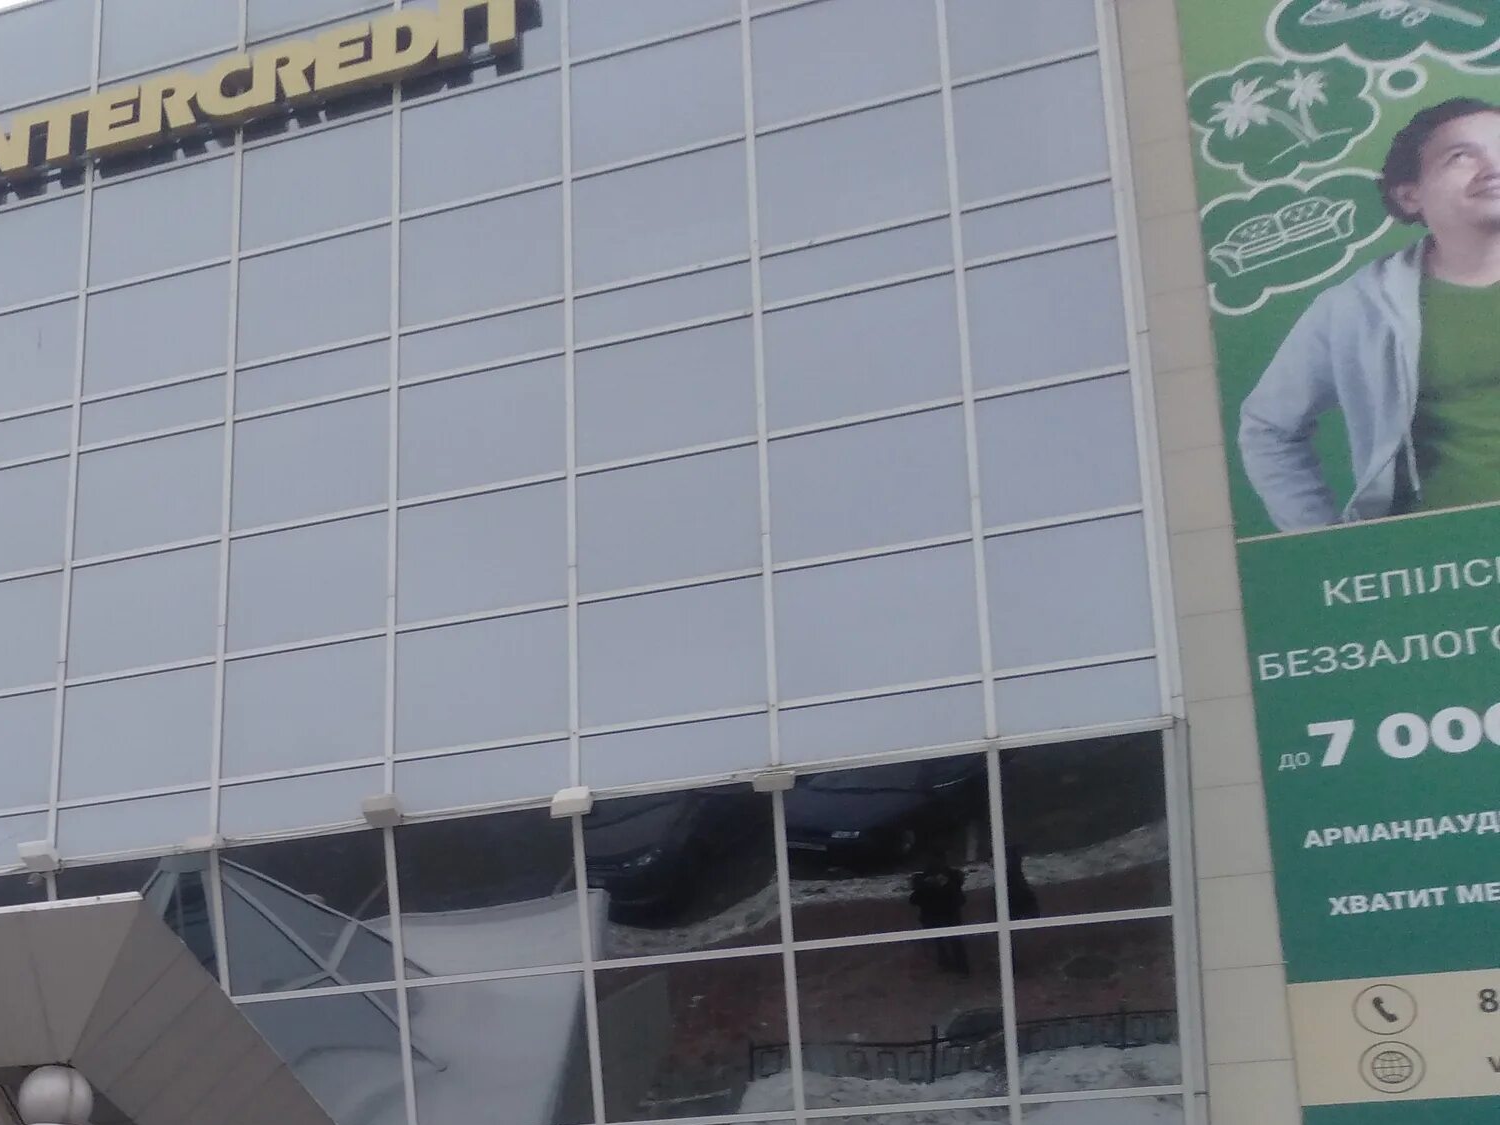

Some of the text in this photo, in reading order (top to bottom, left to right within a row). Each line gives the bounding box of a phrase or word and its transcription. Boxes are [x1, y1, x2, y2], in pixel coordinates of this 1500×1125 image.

[1323, 556, 1500, 606] КЕПІЛС
[1278, 752, 1310, 771] до
[1308, 719, 1355, 768] 7
[1303, 811, 1500, 849] АРМАНДАУД
[1329, 887, 1449, 916] ХВАТИТ
